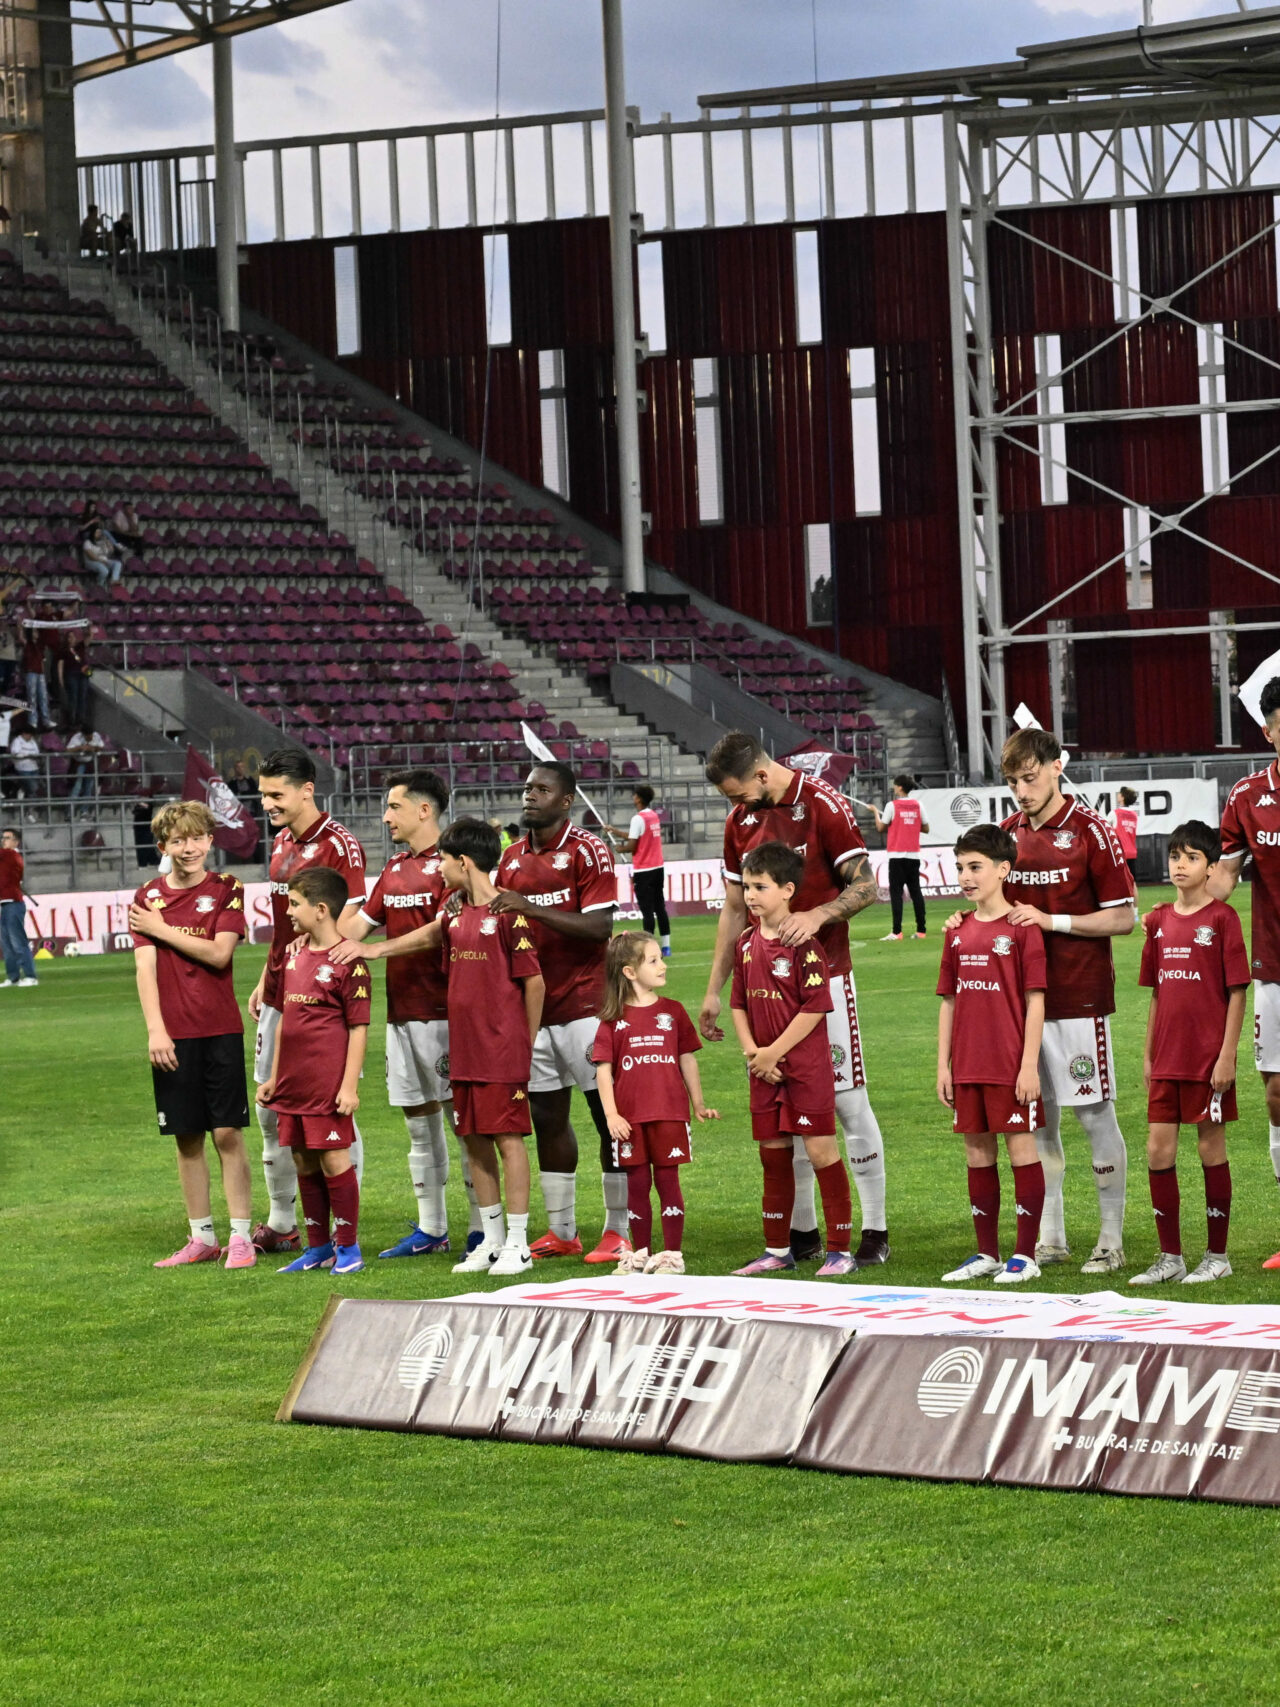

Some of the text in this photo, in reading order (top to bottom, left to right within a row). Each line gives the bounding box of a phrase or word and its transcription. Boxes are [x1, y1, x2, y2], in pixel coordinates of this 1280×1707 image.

[1003, 867, 1070, 886] UPERBET
[173, 925, 206, 936] EOLIA
[458, 951, 488, 961] VEOLIA
[1164, 969, 1202, 981] VEOLIA
[962, 980, 1001, 992] VEOLIA
[287, 993, 319, 1005] VEOLIA
[634, 1054, 676, 1065] VEOLIA
[519, 1288, 684, 1305] DA
[658, 1299, 1032, 1325] pentru
[448, 1334, 742, 1403] IMAMED
[1151, 1440, 1169, 1455] DE
